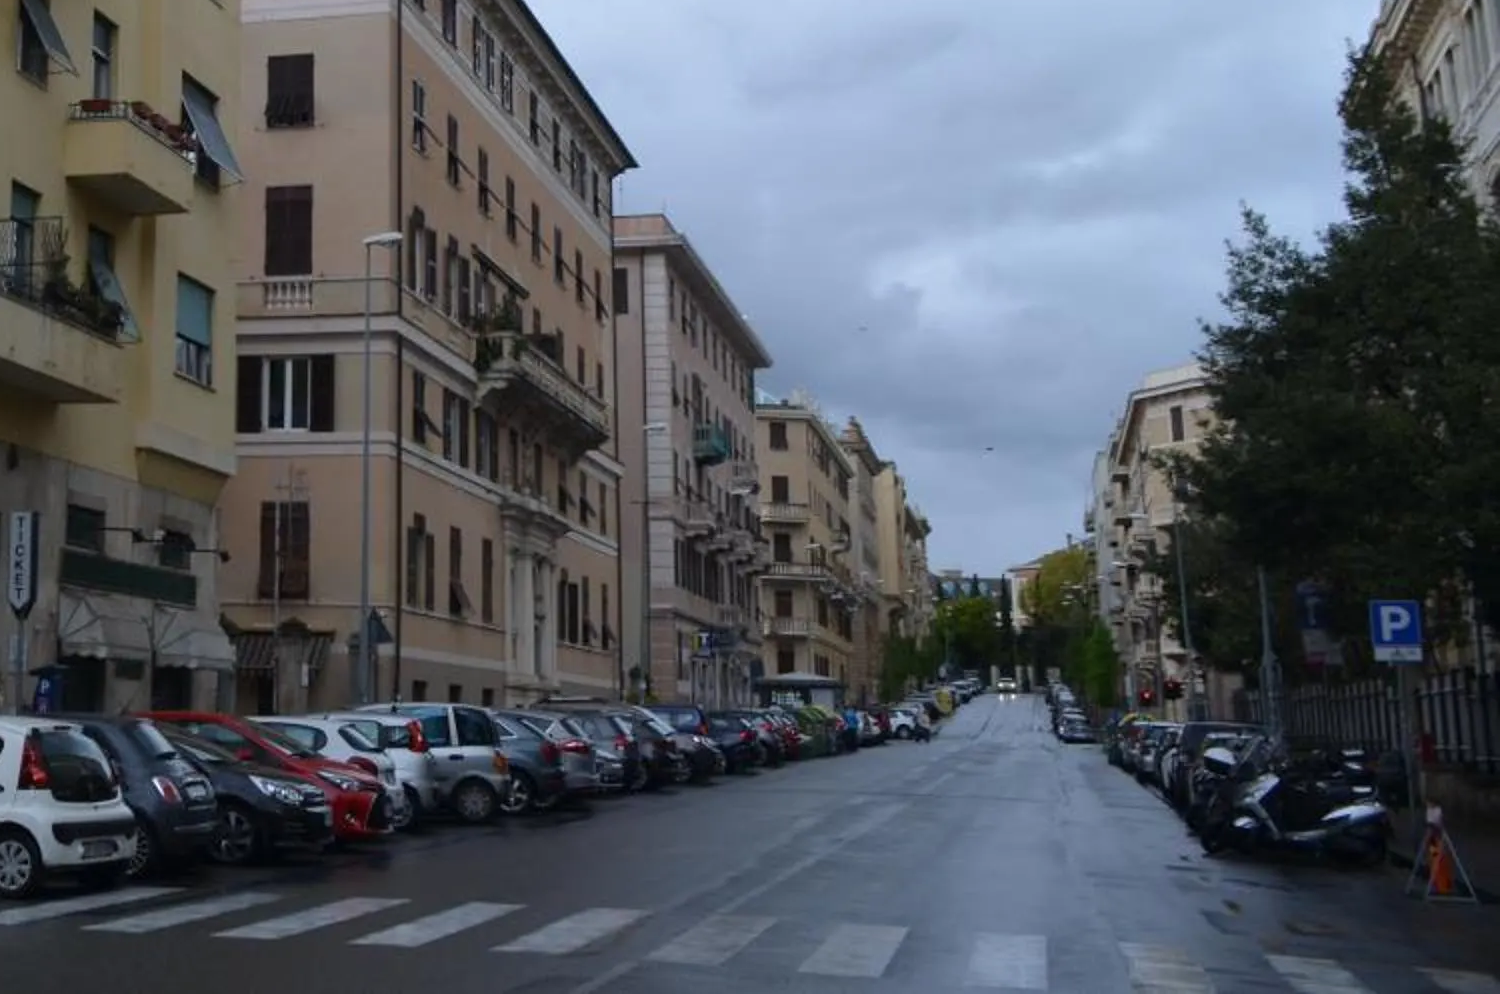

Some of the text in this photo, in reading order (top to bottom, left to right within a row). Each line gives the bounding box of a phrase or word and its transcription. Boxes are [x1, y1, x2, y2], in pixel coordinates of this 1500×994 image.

[14, 516, 25, 600] TICKET
[1380, 605, 1412, 643] P
[40, 679, 50, 694] P
